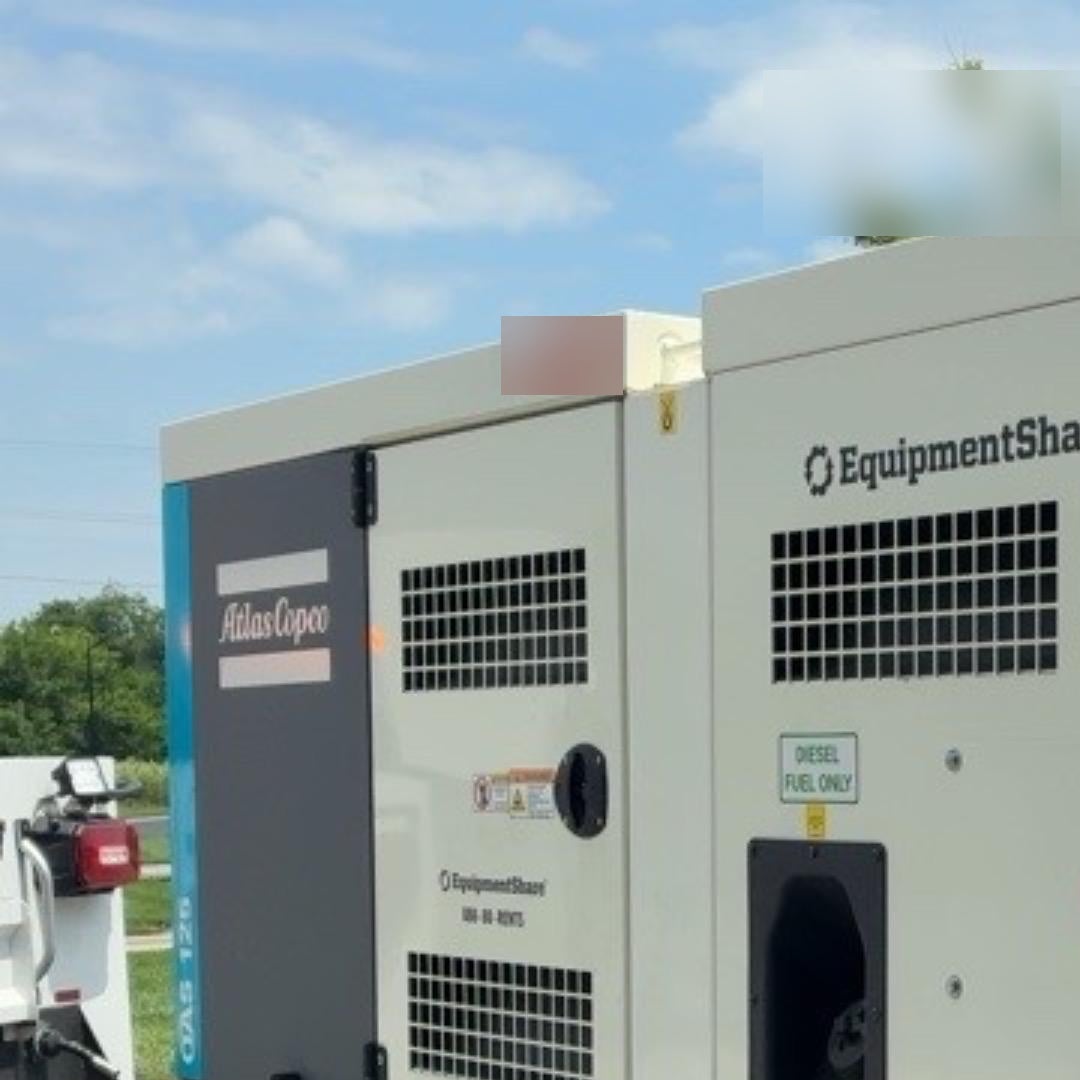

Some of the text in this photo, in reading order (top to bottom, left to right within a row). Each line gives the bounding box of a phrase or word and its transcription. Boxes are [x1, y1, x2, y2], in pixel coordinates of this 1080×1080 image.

[795, 744, 840, 765] DIESEL
[785, 772, 853, 793] FUEL ONLY
[451, 871, 546, 897] EquipmentShare
